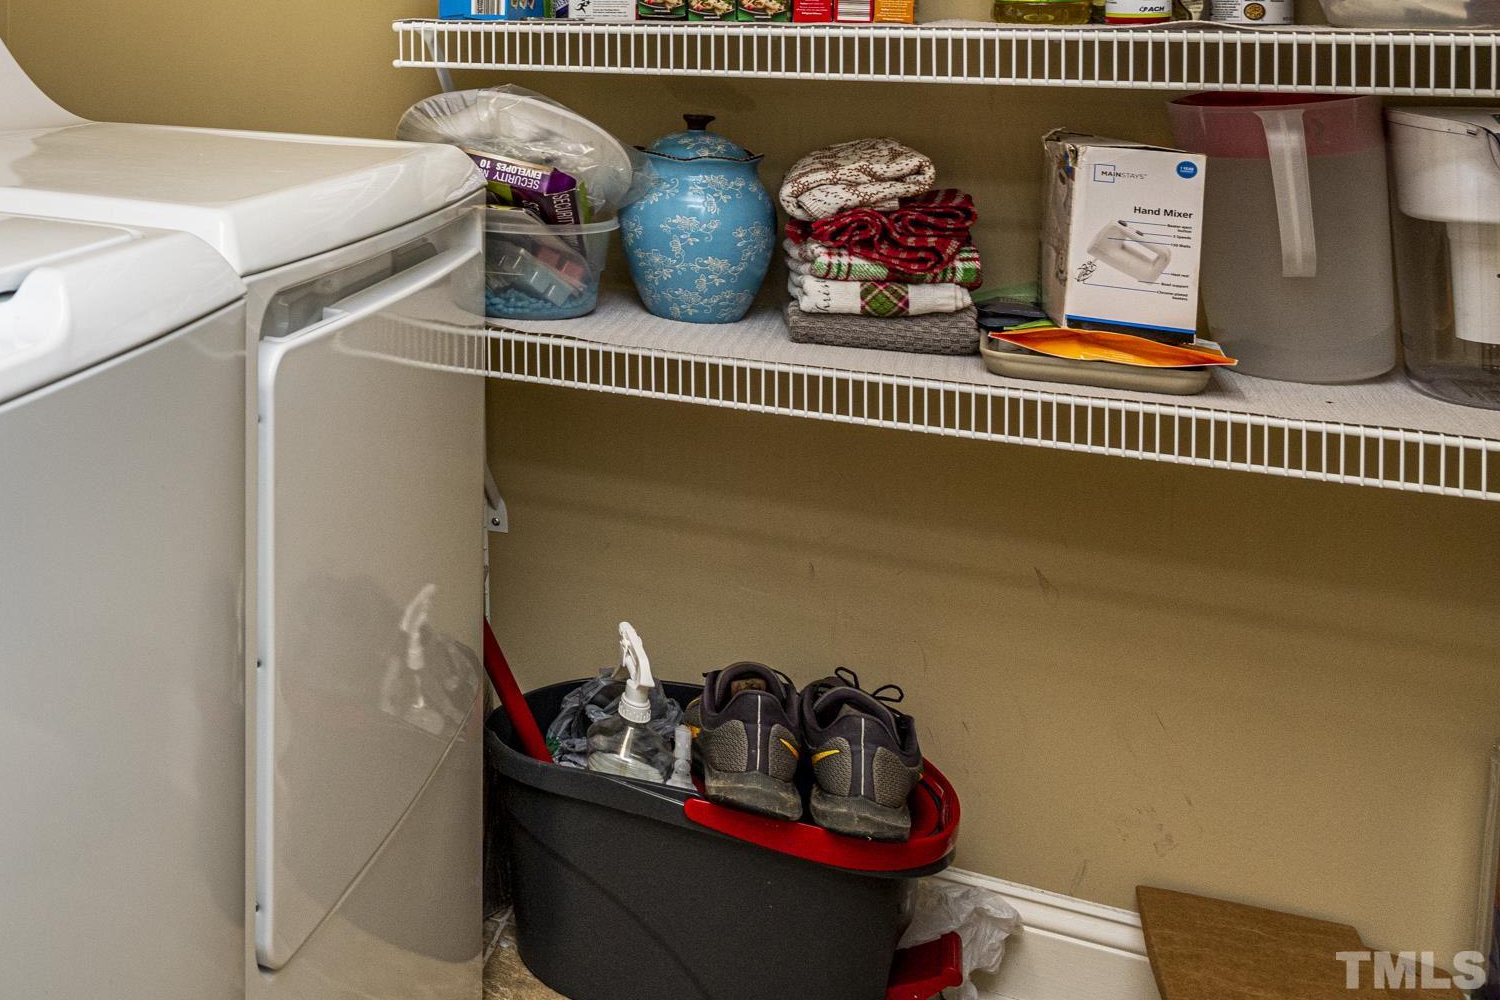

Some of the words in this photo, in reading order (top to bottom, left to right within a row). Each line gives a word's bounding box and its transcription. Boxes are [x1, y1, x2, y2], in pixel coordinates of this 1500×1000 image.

[479, 158, 491, 169] 10
[495, 163, 543, 180] ENVELOPES
[1101, 170, 1146, 180] MAINSTAYS
[492, 172, 541, 190] SECURITY
[553, 193, 576, 225] SECURIT
[1133, 206, 1160, 217] Hand
[1163, 208, 1194, 219] Mixer
